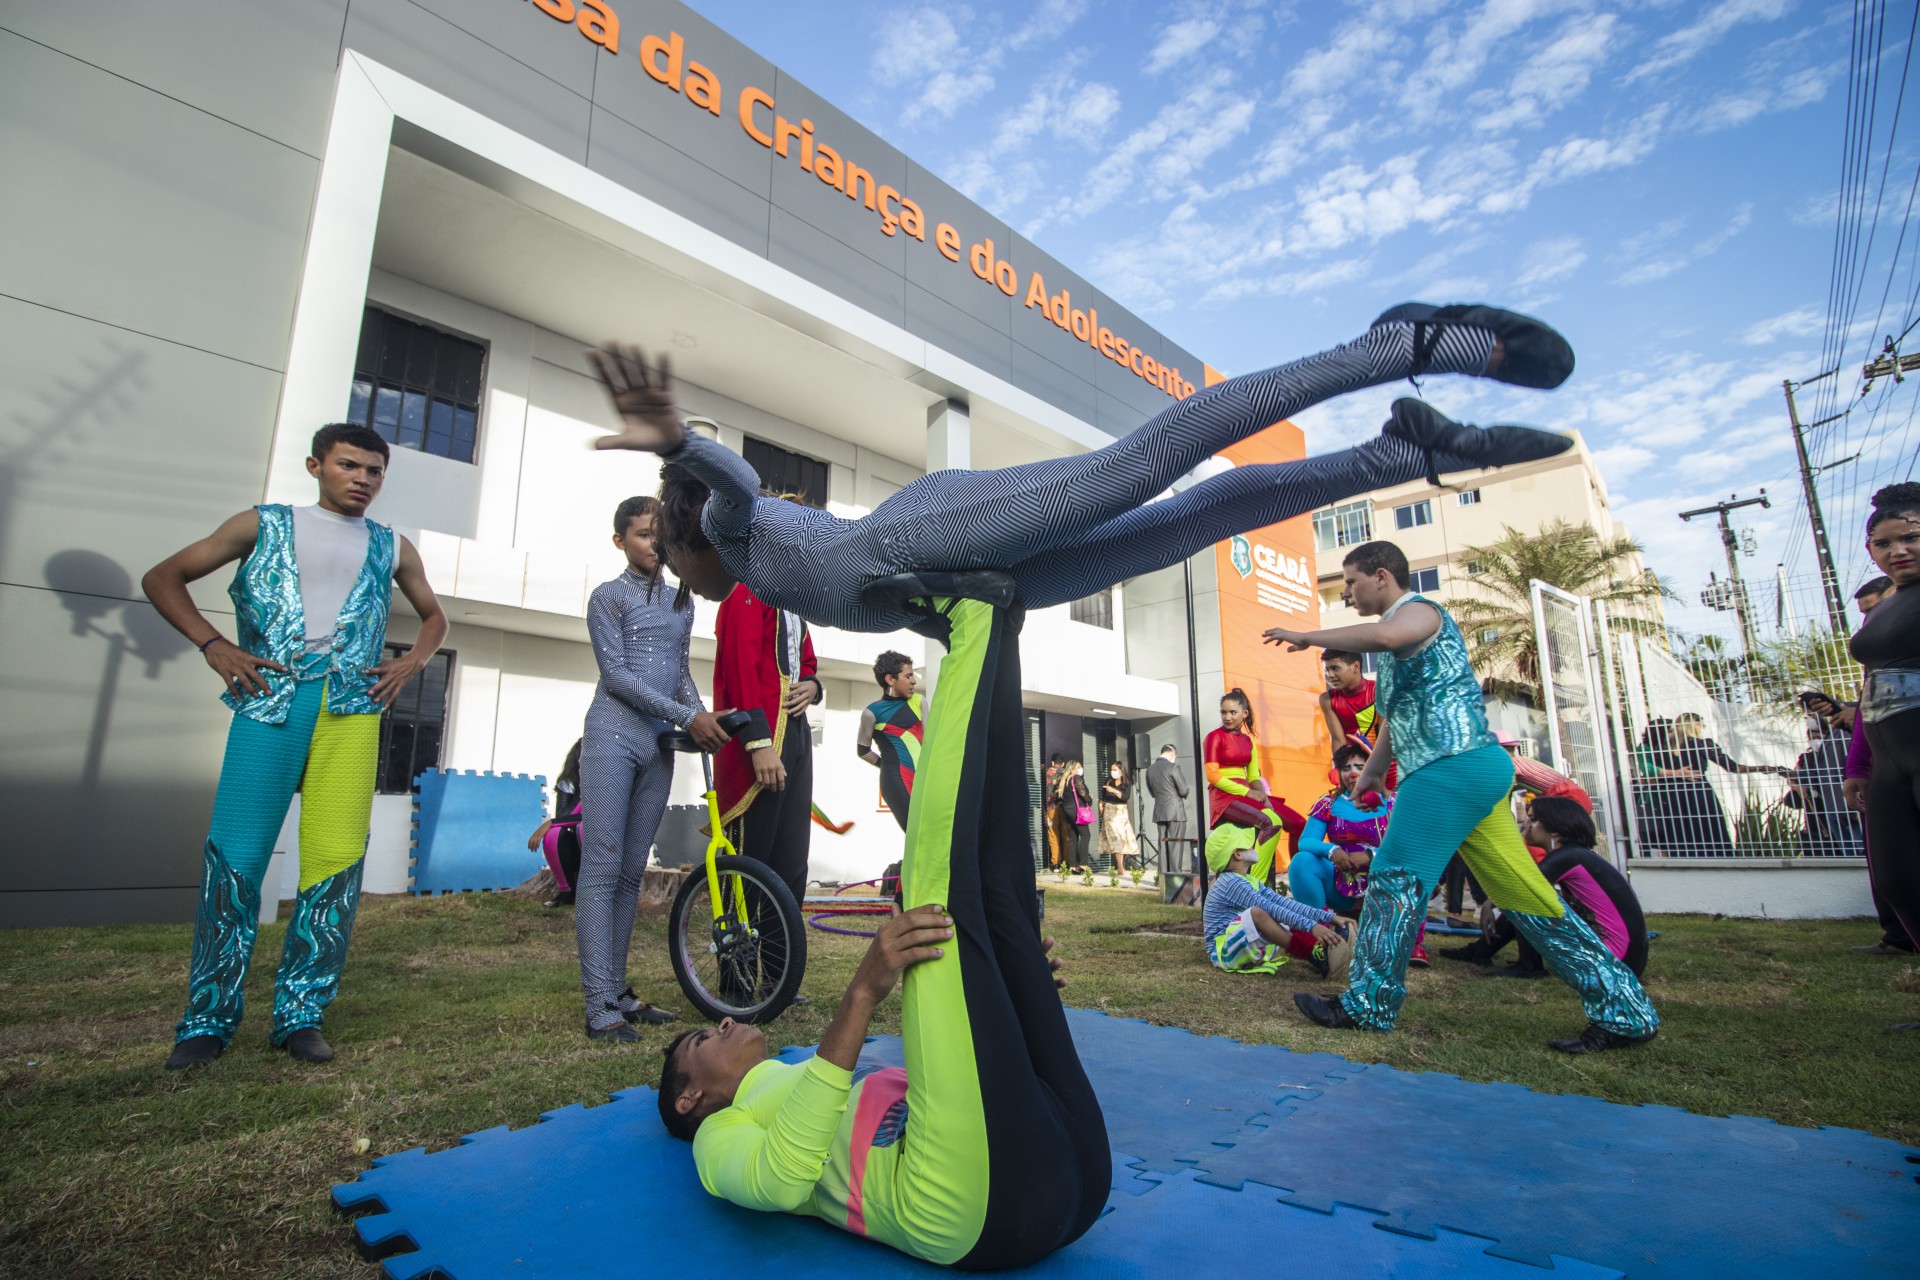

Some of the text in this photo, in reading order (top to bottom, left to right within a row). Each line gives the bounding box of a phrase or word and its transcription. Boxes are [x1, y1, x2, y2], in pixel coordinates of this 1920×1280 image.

[640, 31, 722, 116] da
[739, 87, 925, 242] Criança
[936, 222, 961, 264] e
[970, 239, 1017, 298] do
[1253, 544, 1312, 588] CEARÁ
